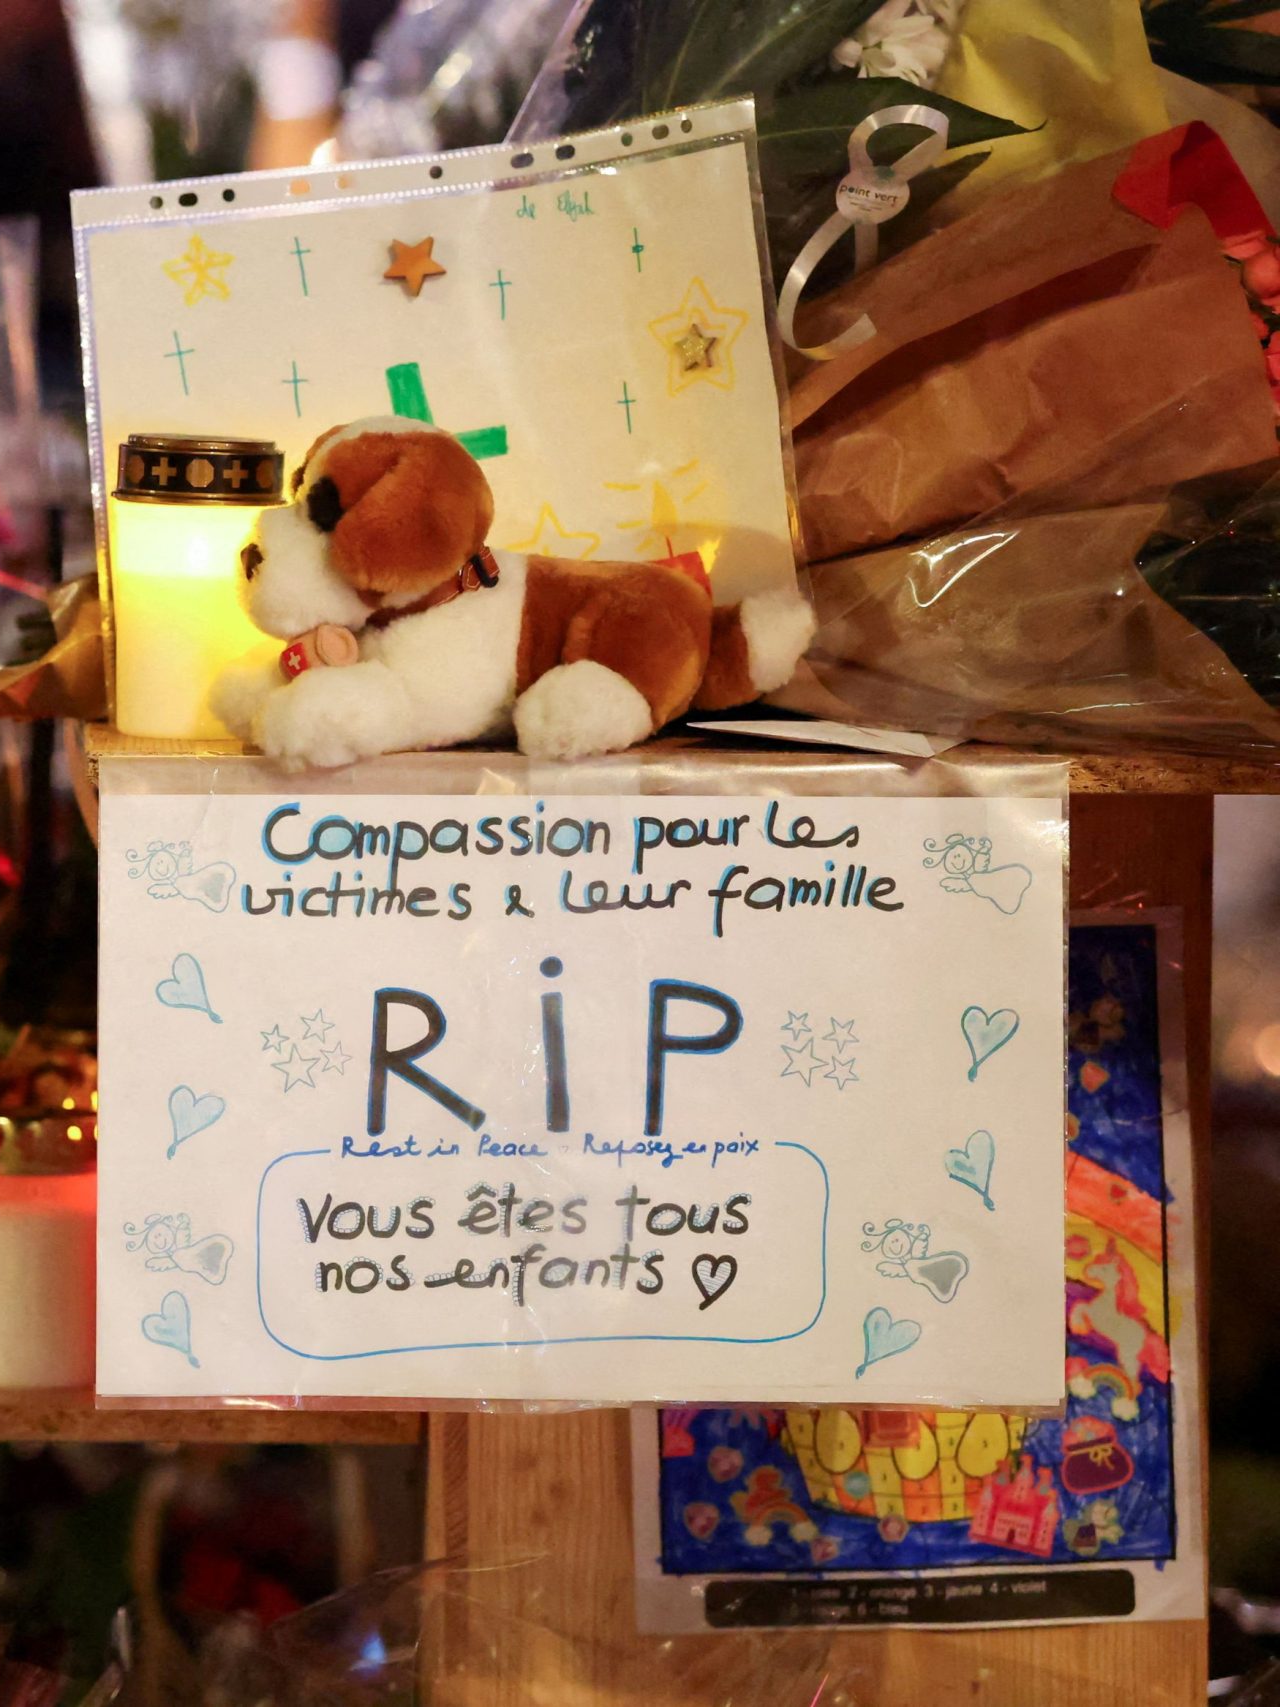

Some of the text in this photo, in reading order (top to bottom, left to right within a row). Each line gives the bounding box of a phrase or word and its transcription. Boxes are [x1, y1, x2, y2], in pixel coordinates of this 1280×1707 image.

[261, 800, 611, 892] Compassion
[631, 814, 750, 875] pour
[241, 859, 905, 938] victimes & leur famille
[341, 1134, 422, 1159] Rest
[426, 1137, 460, 1158] in
[477, 1133, 549, 1158] Peace
[711, 1131, 760, 1169] paix
[457, 1180, 590, 1239] êtes
[614, 1183, 753, 1243] tous
[314, 1241, 665, 1308] nos enfants
[1010, 1580, 1047, 1594] violet
